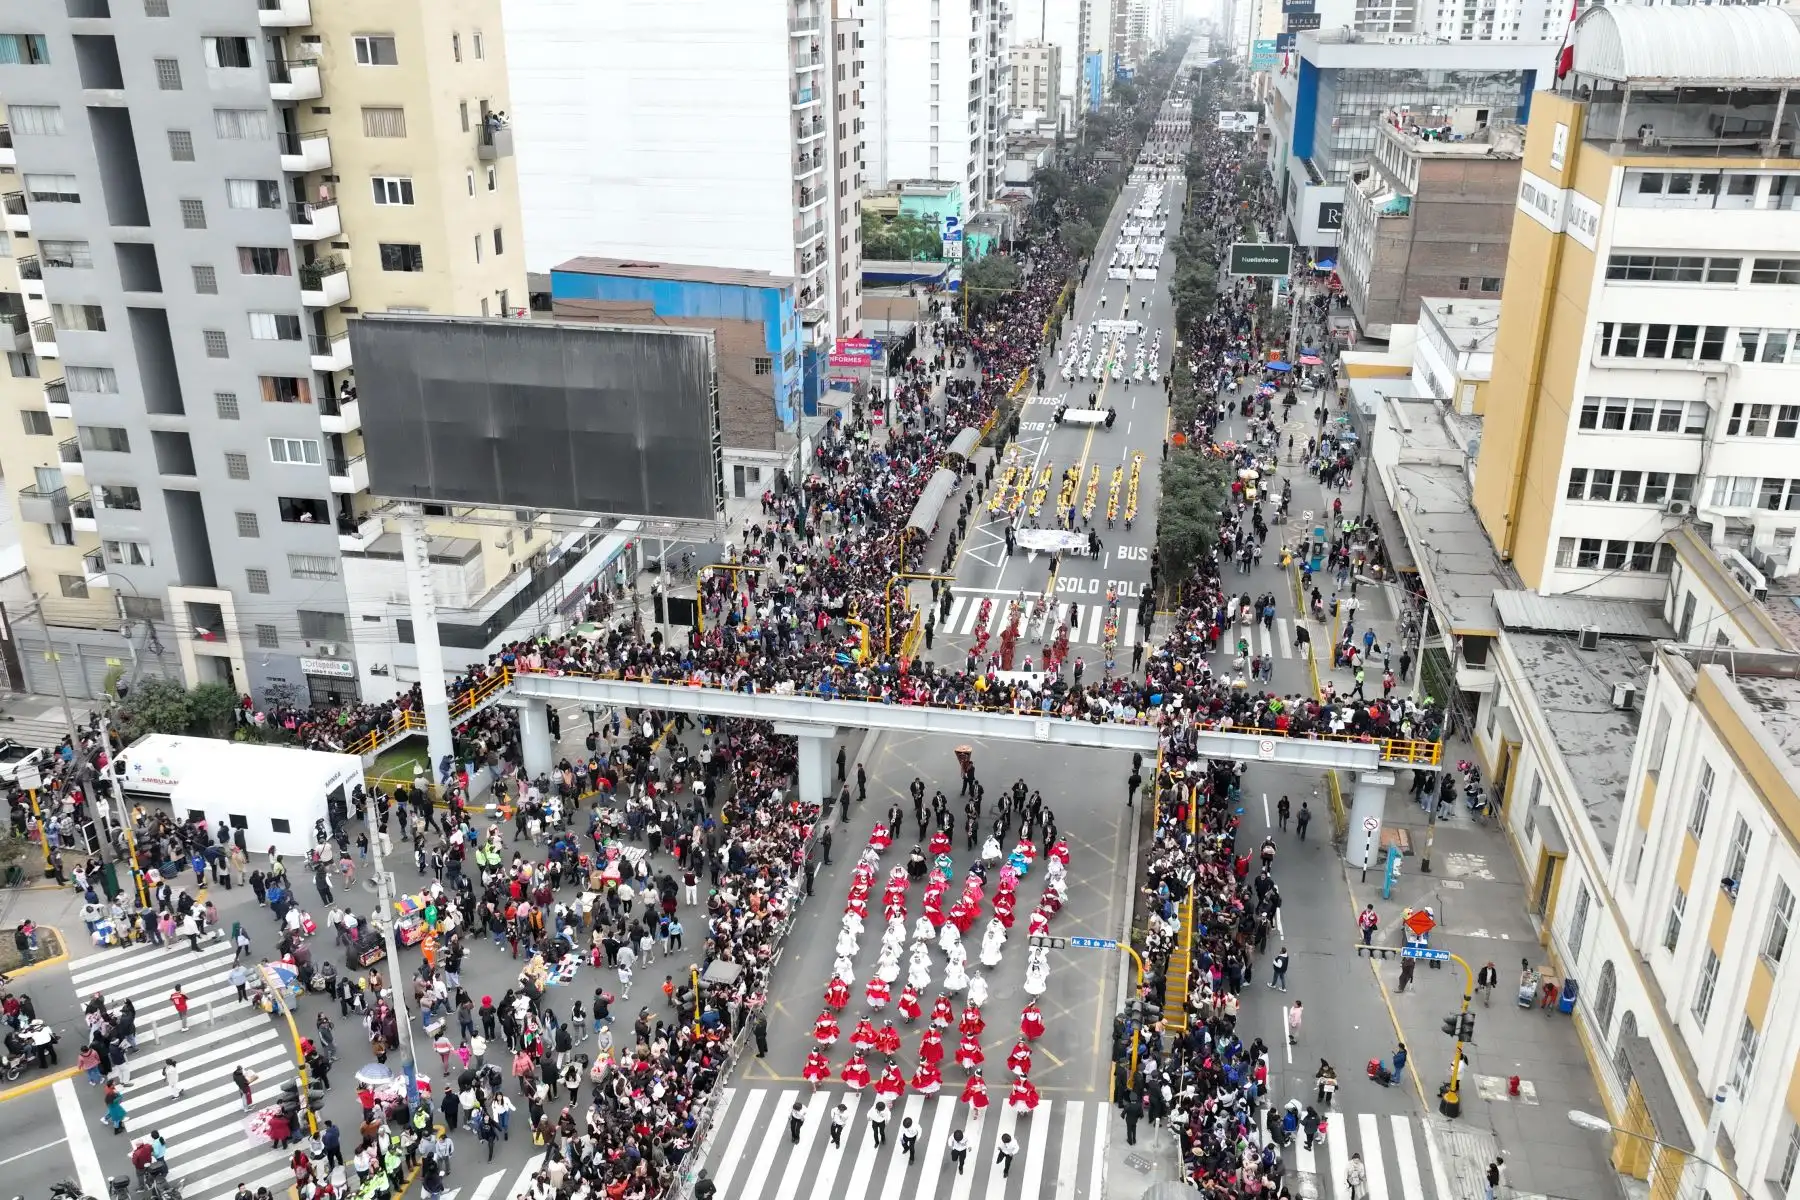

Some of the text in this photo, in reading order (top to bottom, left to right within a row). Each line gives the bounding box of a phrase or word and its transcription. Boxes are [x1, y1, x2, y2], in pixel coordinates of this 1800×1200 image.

[1117, 545, 1148, 561] BUS
[1056, 576, 1099, 594] SOLO
[142, 777, 179, 785] AMBULAN
